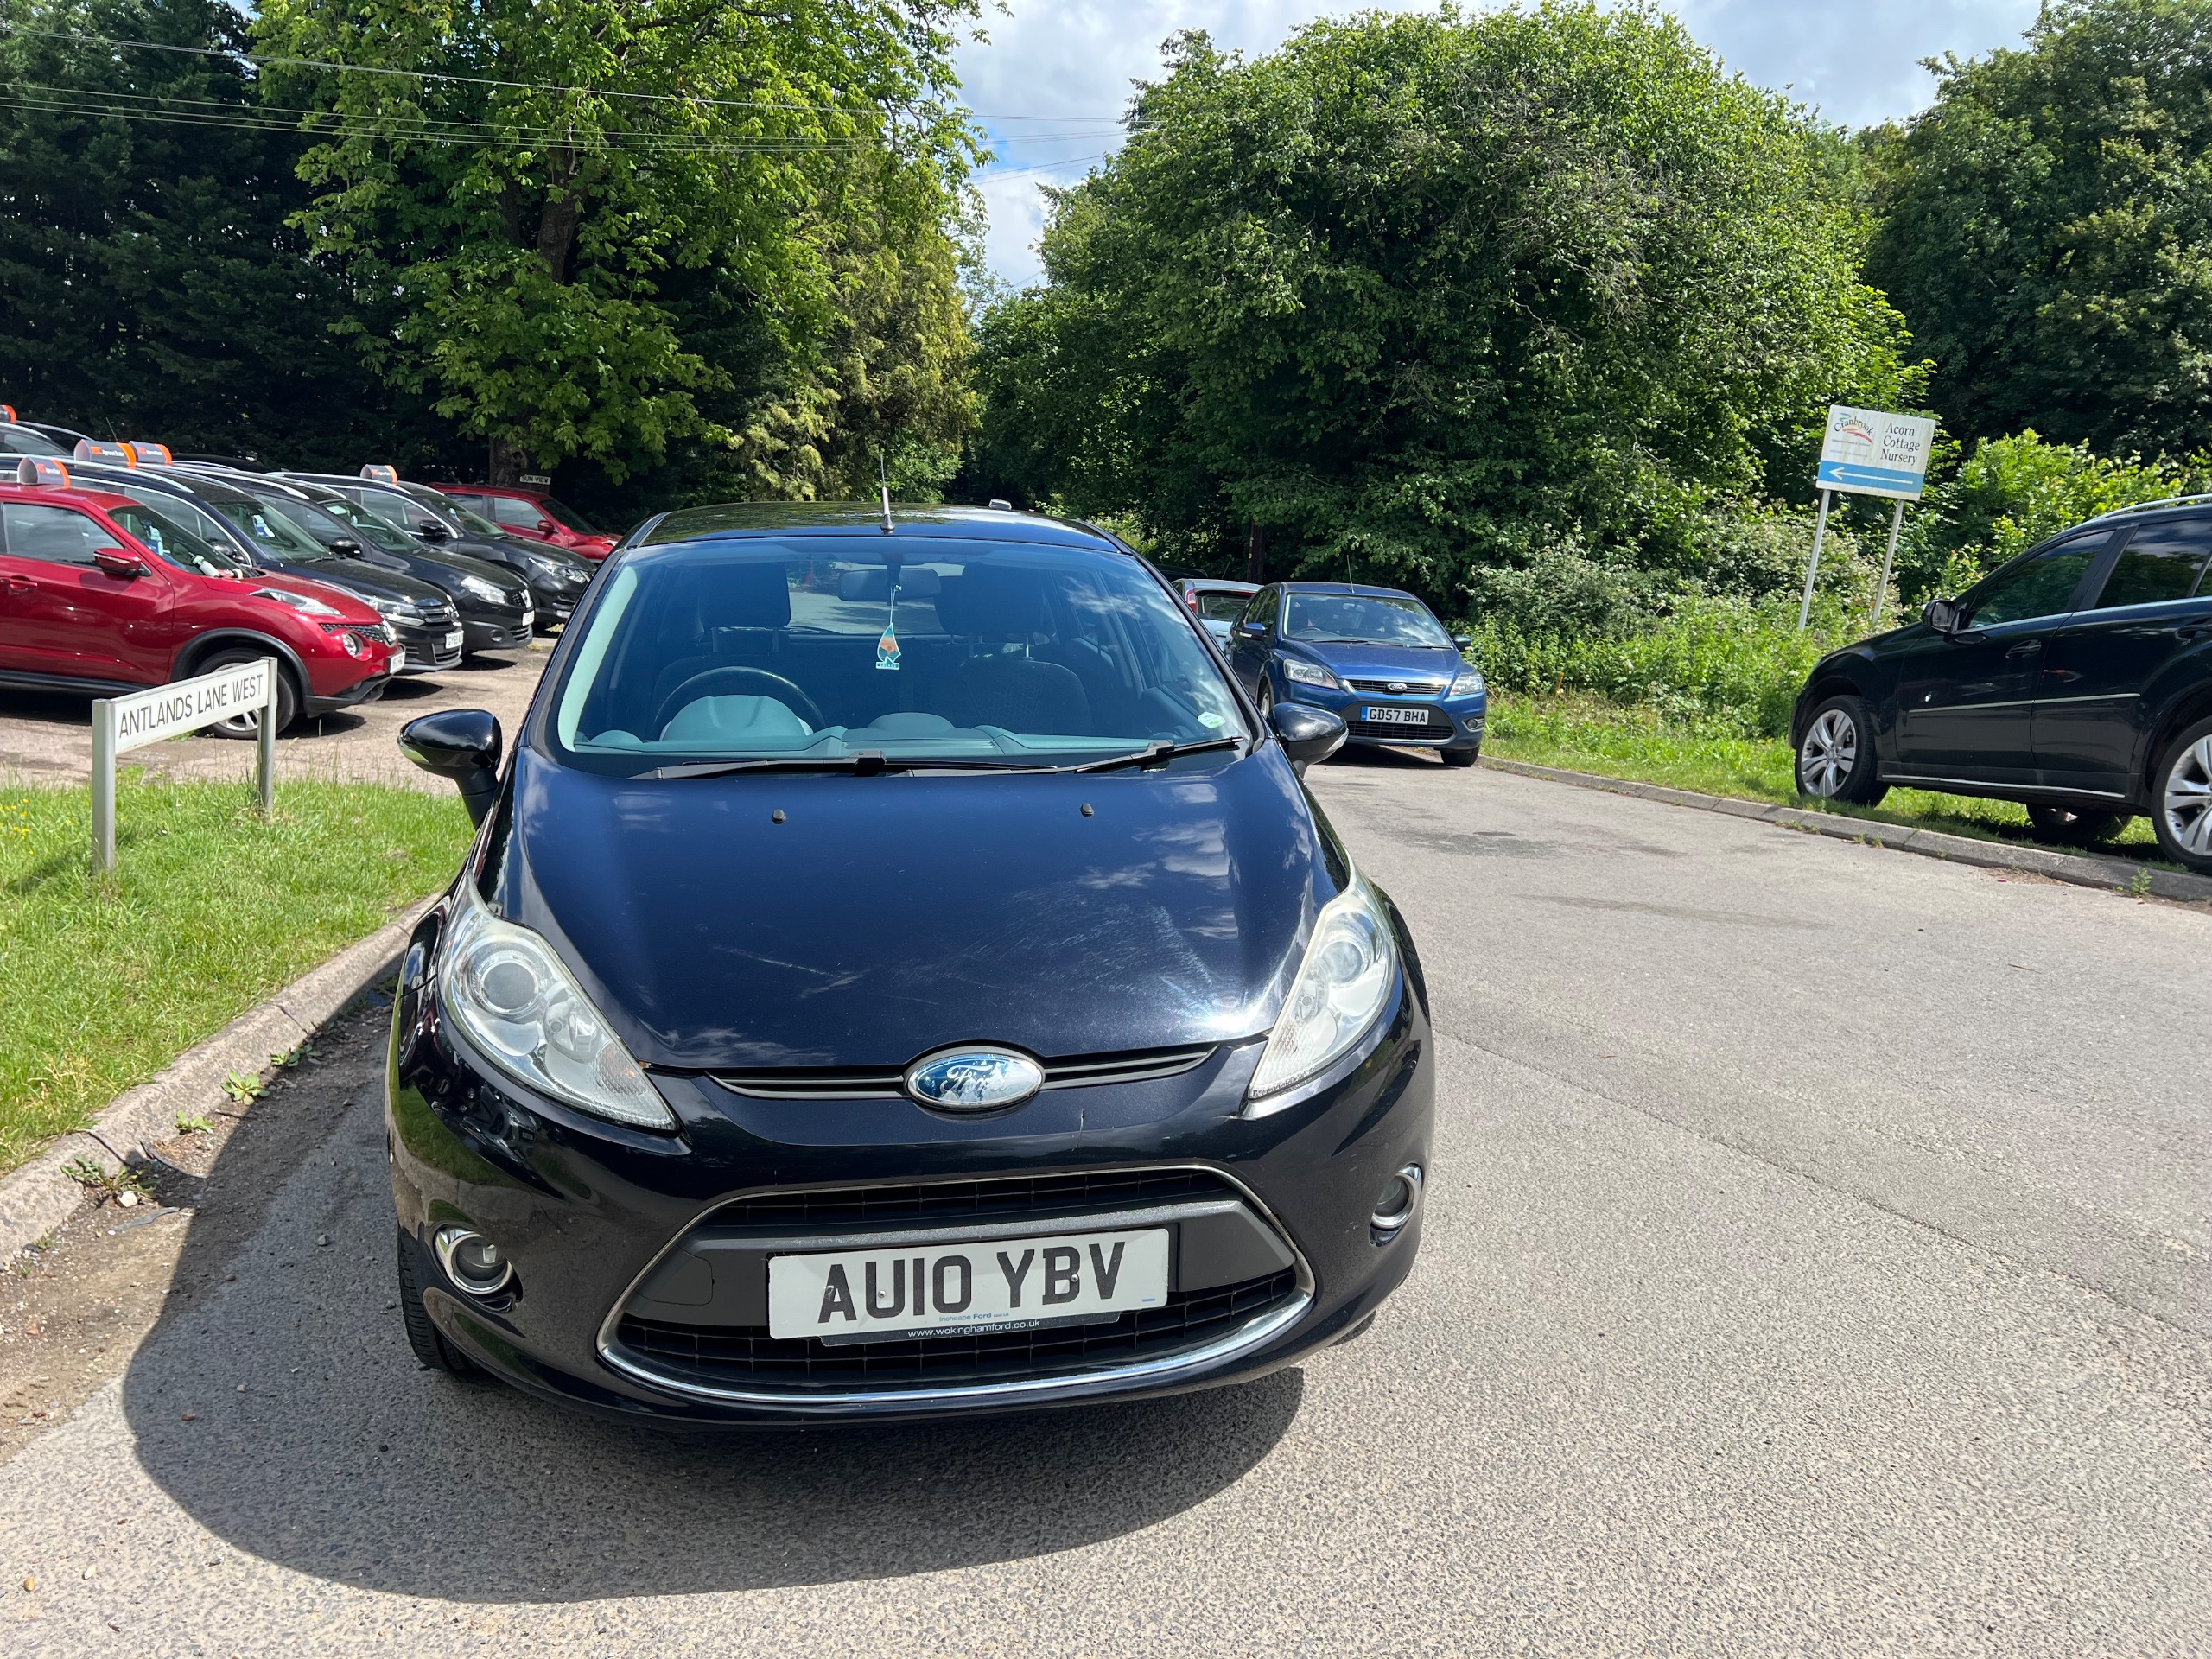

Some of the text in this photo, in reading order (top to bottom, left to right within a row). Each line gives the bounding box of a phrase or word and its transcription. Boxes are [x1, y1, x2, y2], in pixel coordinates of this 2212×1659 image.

[1834, 416, 1873, 436] Cranbrook
[1885, 423, 1915, 436] Acorn
[1883, 435, 1920, 452] Cottage
[1880, 448, 1917, 466] Nursery
[119, 674, 263, 738] ANTLANDS LANE WEST
[1370, 709, 1426, 723] GD57 BHA
[940, 1061, 1009, 1096] Ford
[817, 1242, 1125, 1324] AU10 YBV
[939, 1314, 971, 1323] Inchcape
[908, 1319, 1040, 1337] www.wokinghamford.co.uk
